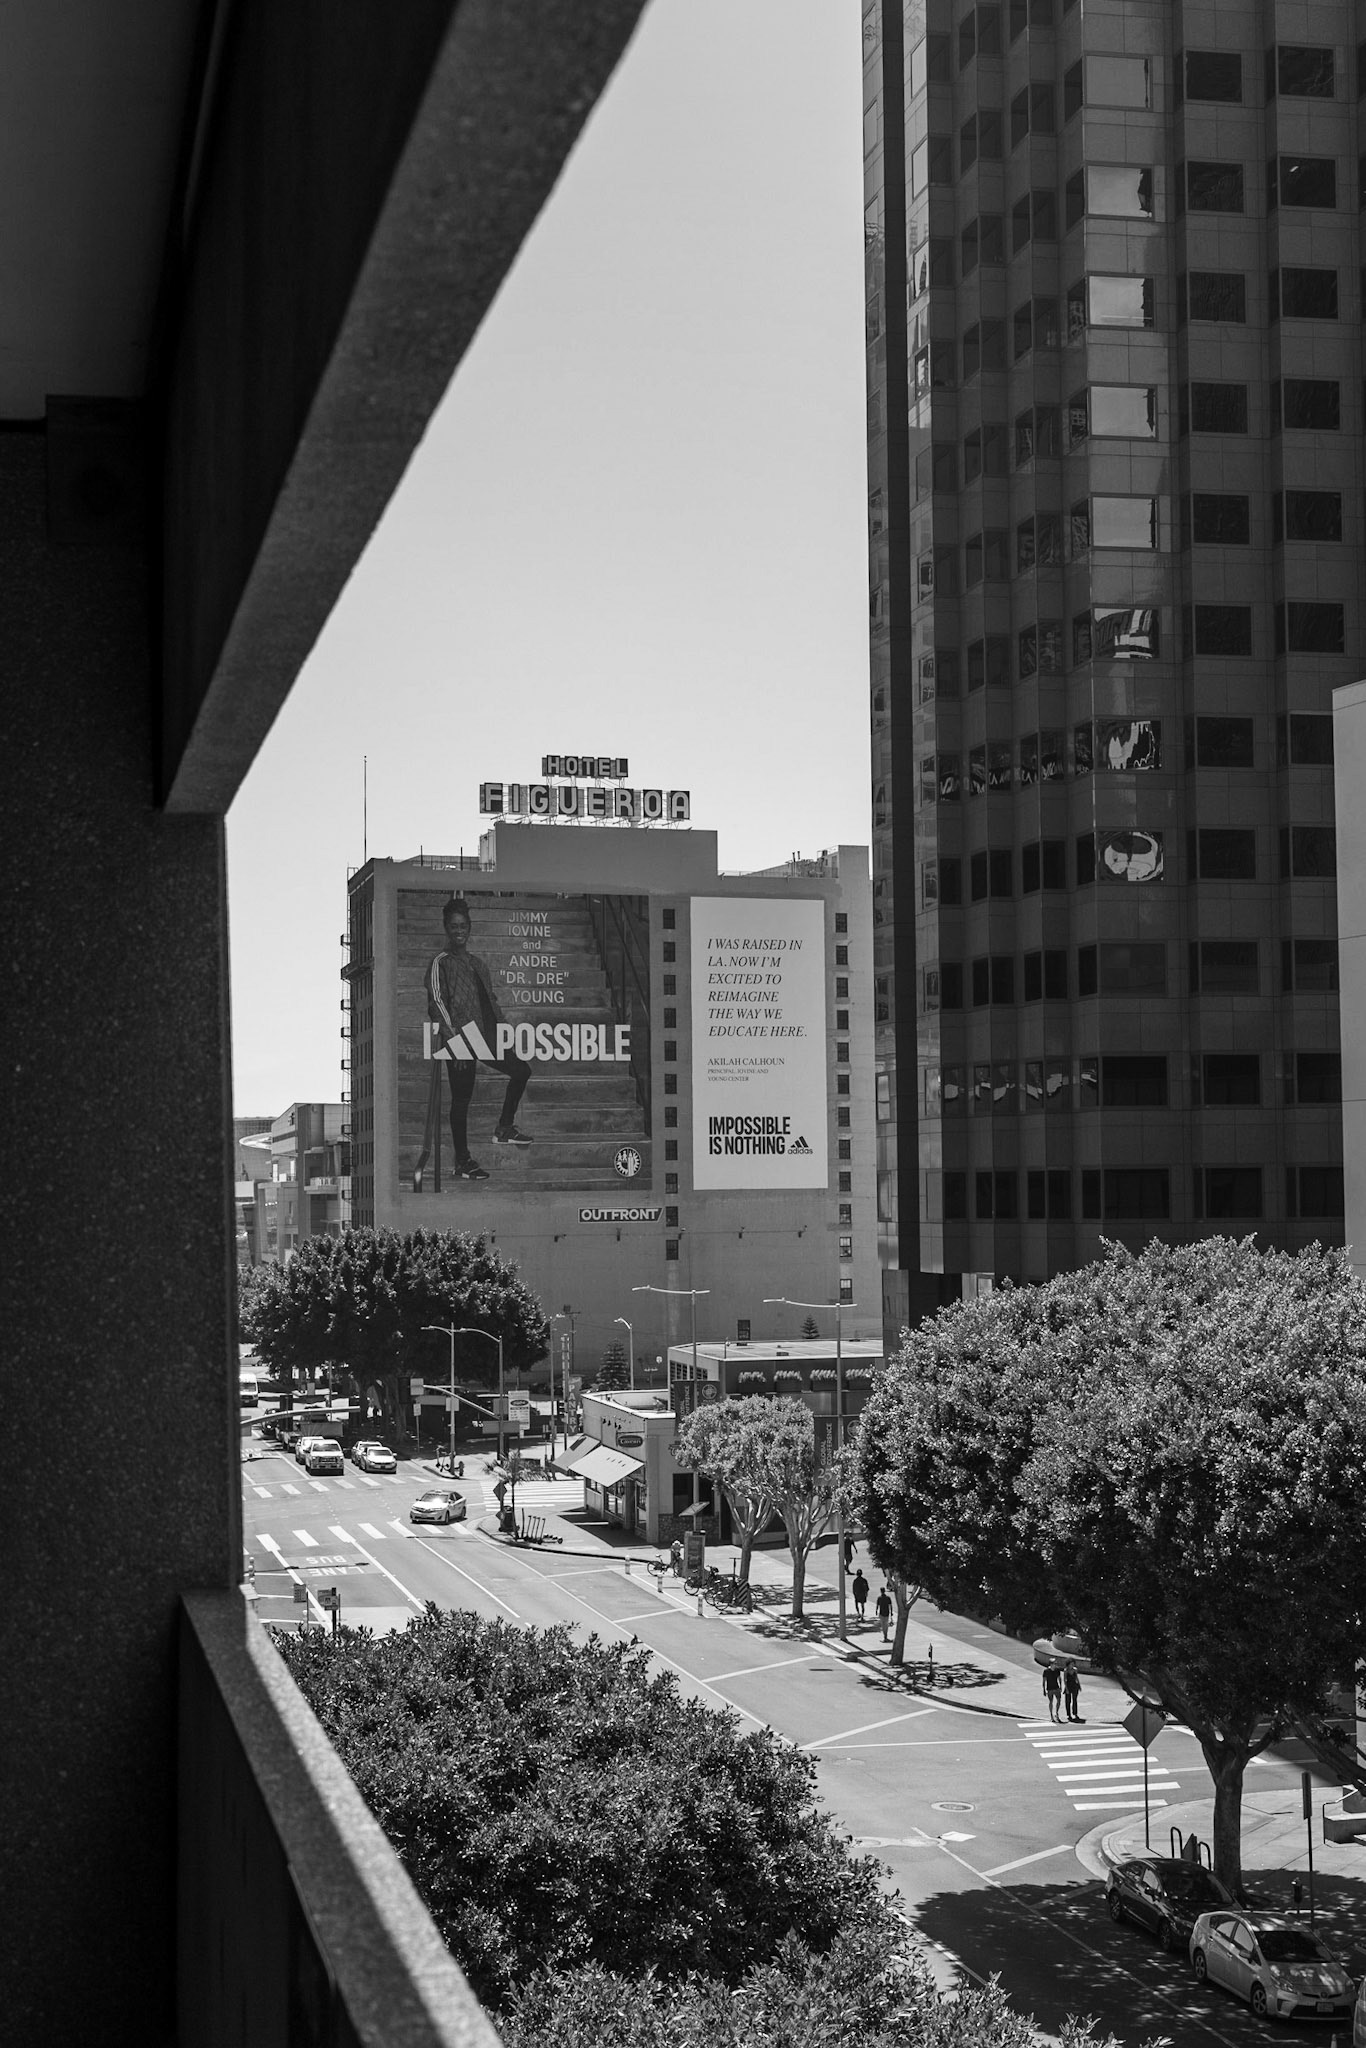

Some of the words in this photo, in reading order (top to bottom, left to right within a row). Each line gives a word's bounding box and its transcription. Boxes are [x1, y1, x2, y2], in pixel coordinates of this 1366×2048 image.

[547, 756, 628, 777] HOTEL
[485, 783, 689, 819] FIGUEROA
[509, 912, 548, 923] JIMMY
[508, 925, 551, 937] IOVINE
[522, 941, 541, 950] and
[708, 938, 713, 949] I
[715, 938, 740, 950] WAS
[742, 938, 787, 950] RAISED
[789, 939, 803, 951] IN
[509, 955, 557, 968] ANDRE
[729, 956, 760, 967] NOW
[761, 956, 782, 967] I'M
[500, 970, 532, 984] "DR.
[536, 972, 569, 985] DRE"
[708, 973, 763, 985] EXCITED
[765, 973, 782, 985] TO
[512, 990, 564, 1003] YOUNG
[708, 990, 780, 1002] REIMAGINE
[709, 1008, 734, 1019] THE
[737, 1008, 762, 1019] WAY
[764, 1008, 783, 1020] WE
[708, 1026, 769, 1037] EDUCATE
[770, 1026, 808, 1037] HERE.
[707, 1057, 741, 1066] AKILAH
[742, 1057, 785, 1066] CALHOUN
[708, 1116, 791, 1135] IMPOSSIBLE
[708, 1136, 722, 1155] IS
[724, 1136, 786, 1155] NOTHING
[581, 1208, 659, 1221] OUTFRONT
[568, 1384, 577, 1433] PANTRY
[306, 1555, 347, 1564] BUS
[307, 1566, 365, 1577] LANE
